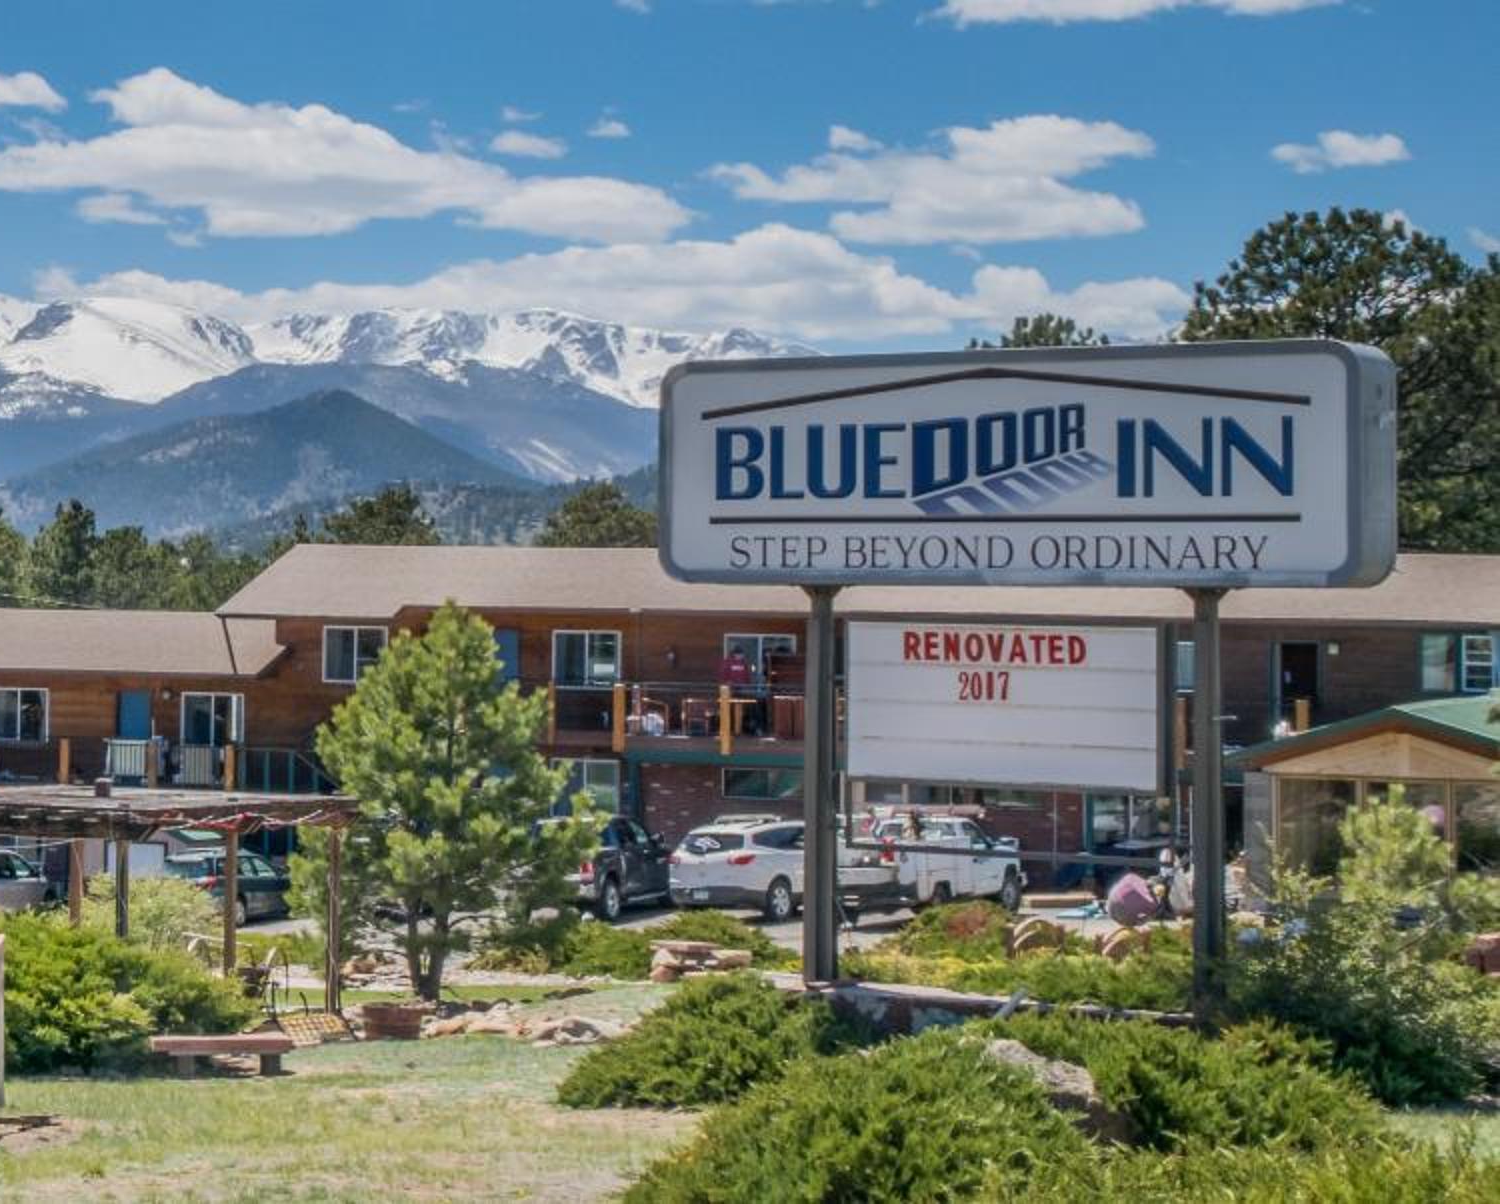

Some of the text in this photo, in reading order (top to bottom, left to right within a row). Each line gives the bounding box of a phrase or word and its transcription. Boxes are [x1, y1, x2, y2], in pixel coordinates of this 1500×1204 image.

[1116, 414, 1294, 498] INN
[729, 535, 1268, 570] STEP BEYOND ORDINARY
[903, 631, 1088, 665] RENOVATED
[958, 671, 1010, 701] 2017
